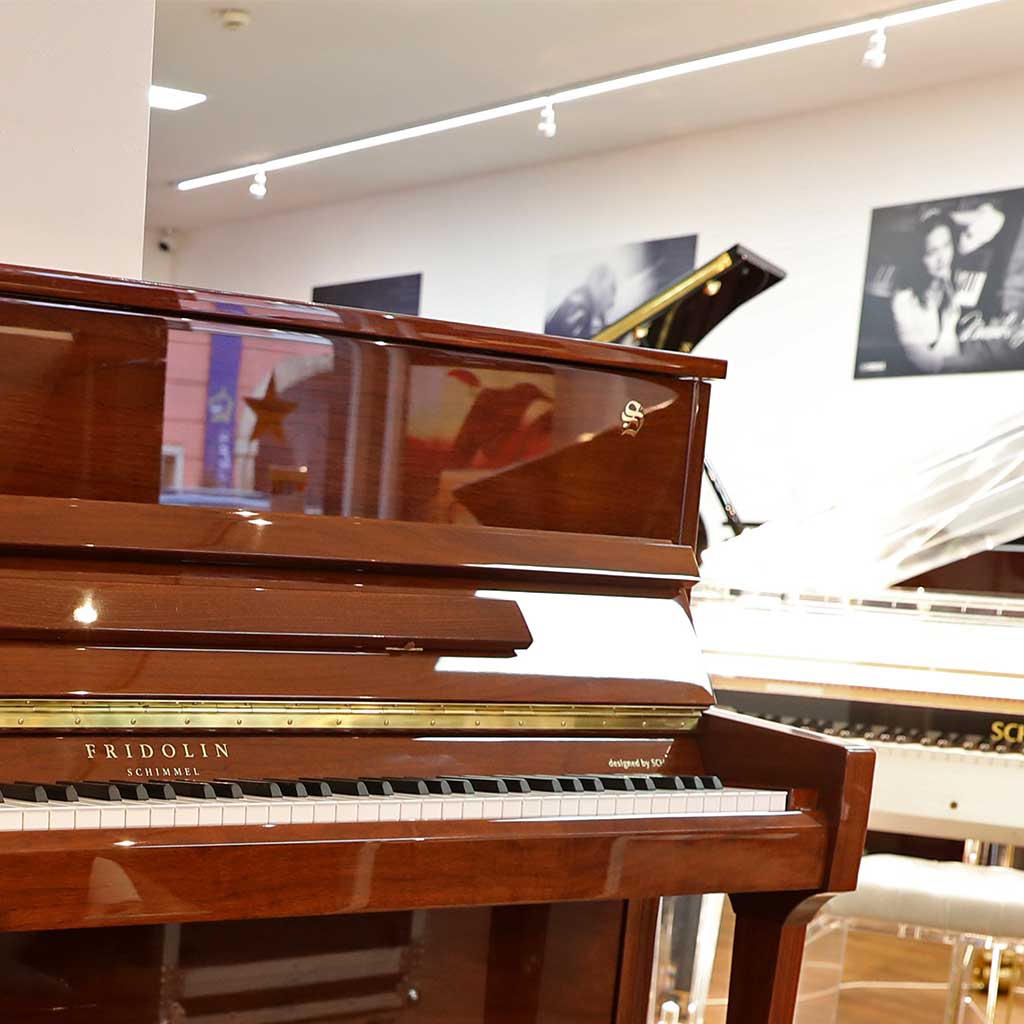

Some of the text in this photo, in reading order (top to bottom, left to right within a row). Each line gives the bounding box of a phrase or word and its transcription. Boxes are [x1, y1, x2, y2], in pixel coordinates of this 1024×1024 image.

[85, 743, 229, 759] FRIDOLIN
[608, 758, 640, 769] designed
[640, 758, 650, 769] by
[127, 767, 200, 776] SCHIMMEL
